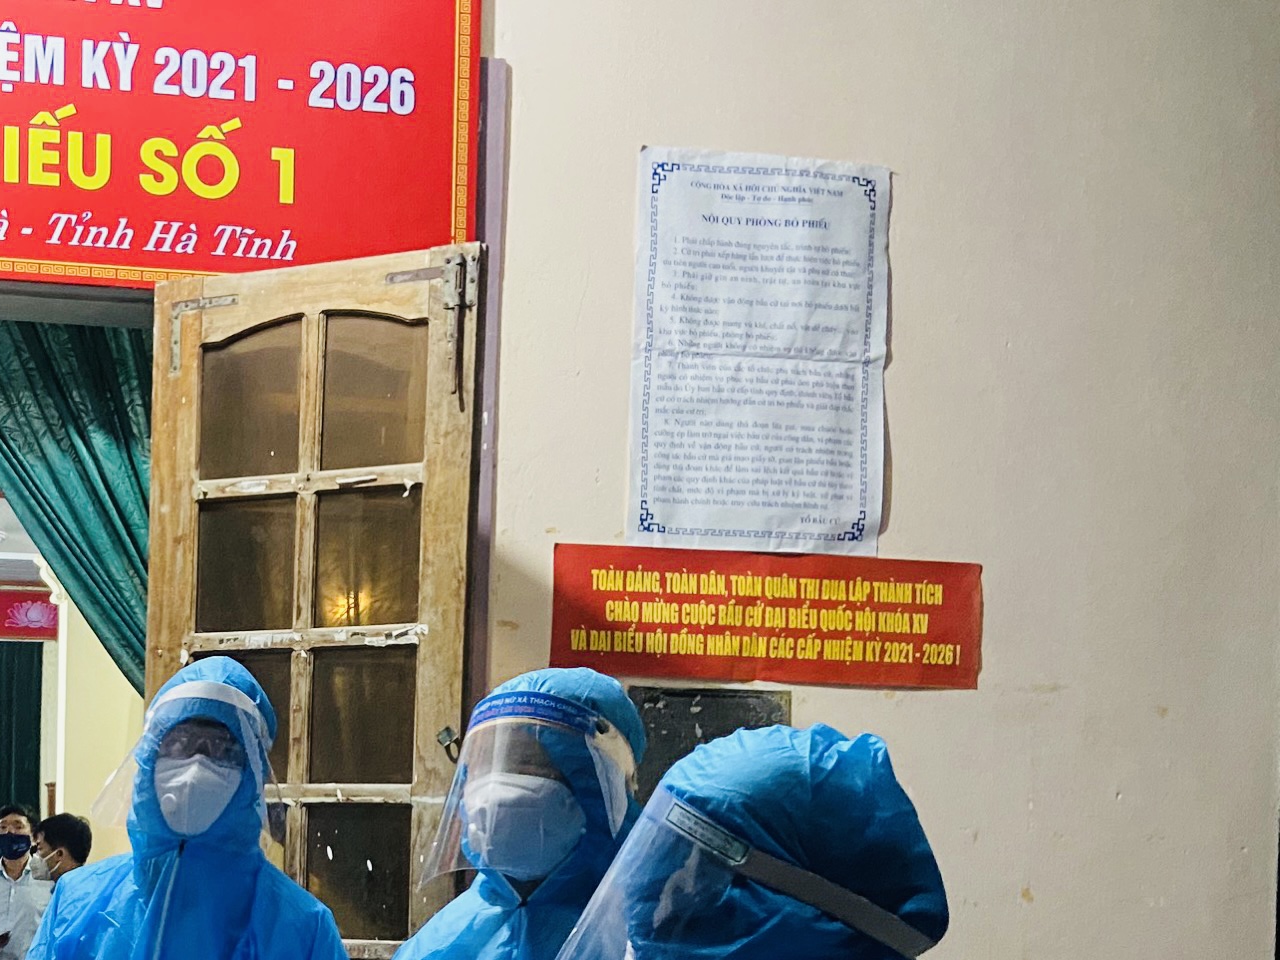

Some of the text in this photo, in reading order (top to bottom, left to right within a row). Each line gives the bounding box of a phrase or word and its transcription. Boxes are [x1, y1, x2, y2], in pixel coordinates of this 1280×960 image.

[81, 31, 140, 92] KỲ
[153, 46, 257, 102] 2021
[308, 60, 416, 115] 2026
[138, 117, 242, 200] SỐ
[270, 147, 295, 204] 1
[690, 180, 711, 189] CỘNG
[827, 188, 843, 197] NAM
[45, 211, 134, 251] Tỉnh
[142, 220, 205, 257] Hà
[210, 225, 297, 262] Tĩnh
[702, 213, 831, 230] NỘI QUY PHÒNG BỎ PHIẾU
[591, 564, 943, 606] TOÀN ĐẢNG, TOÀN DÂN, TOÀN QUÂN THI ĐUA LẬP THÀNH TÍCH
[605, 596, 929, 637] CHÀO MỪNG CUỘC BẦU CỬ ĐẠI BIỂU QUỐC HỘI KHÓA XV
[570, 624, 587, 651] VÀ
[589, 629, 611, 657] ĐẠI
[613, 623, 643, 653] BIỂU
[645, 628, 668, 659] HỘI
[669, 627, 704, 655] ĐỒNG
[706, 630, 740, 657] NHÂN
[768, 633, 794, 660] CÁC
[796, 633, 821, 661] CẤP
[823, 635, 864, 665] NHIỆM
[865, 636, 882, 662] KỲ
[883, 641, 913, 663] 2021
[922, 643, 954, 665] 2026
